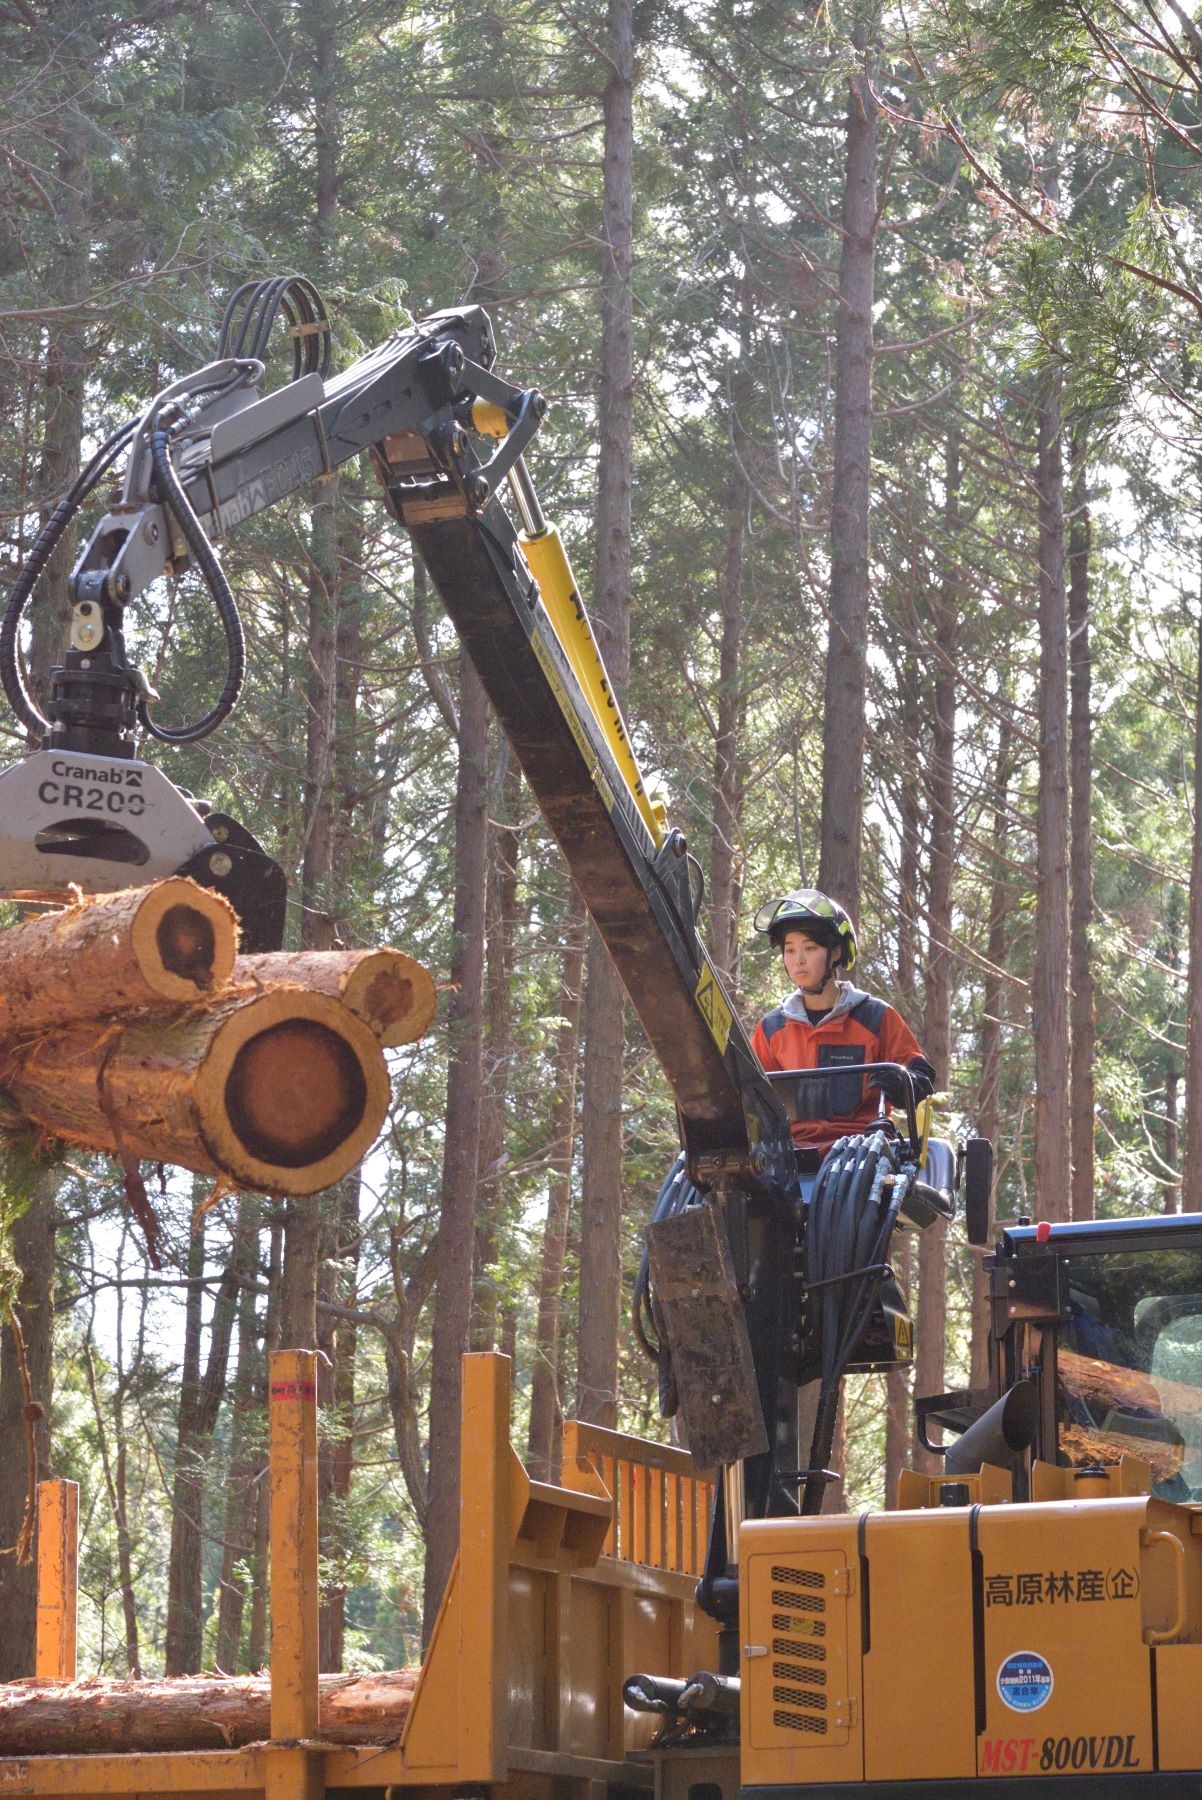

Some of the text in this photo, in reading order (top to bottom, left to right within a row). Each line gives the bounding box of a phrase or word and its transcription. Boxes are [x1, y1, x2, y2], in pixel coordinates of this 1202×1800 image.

[52, 761, 122, 784] Cranab
[38, 781, 146, 816] CR200
[980, 1735, 1140, 1773] MST-800VDL
